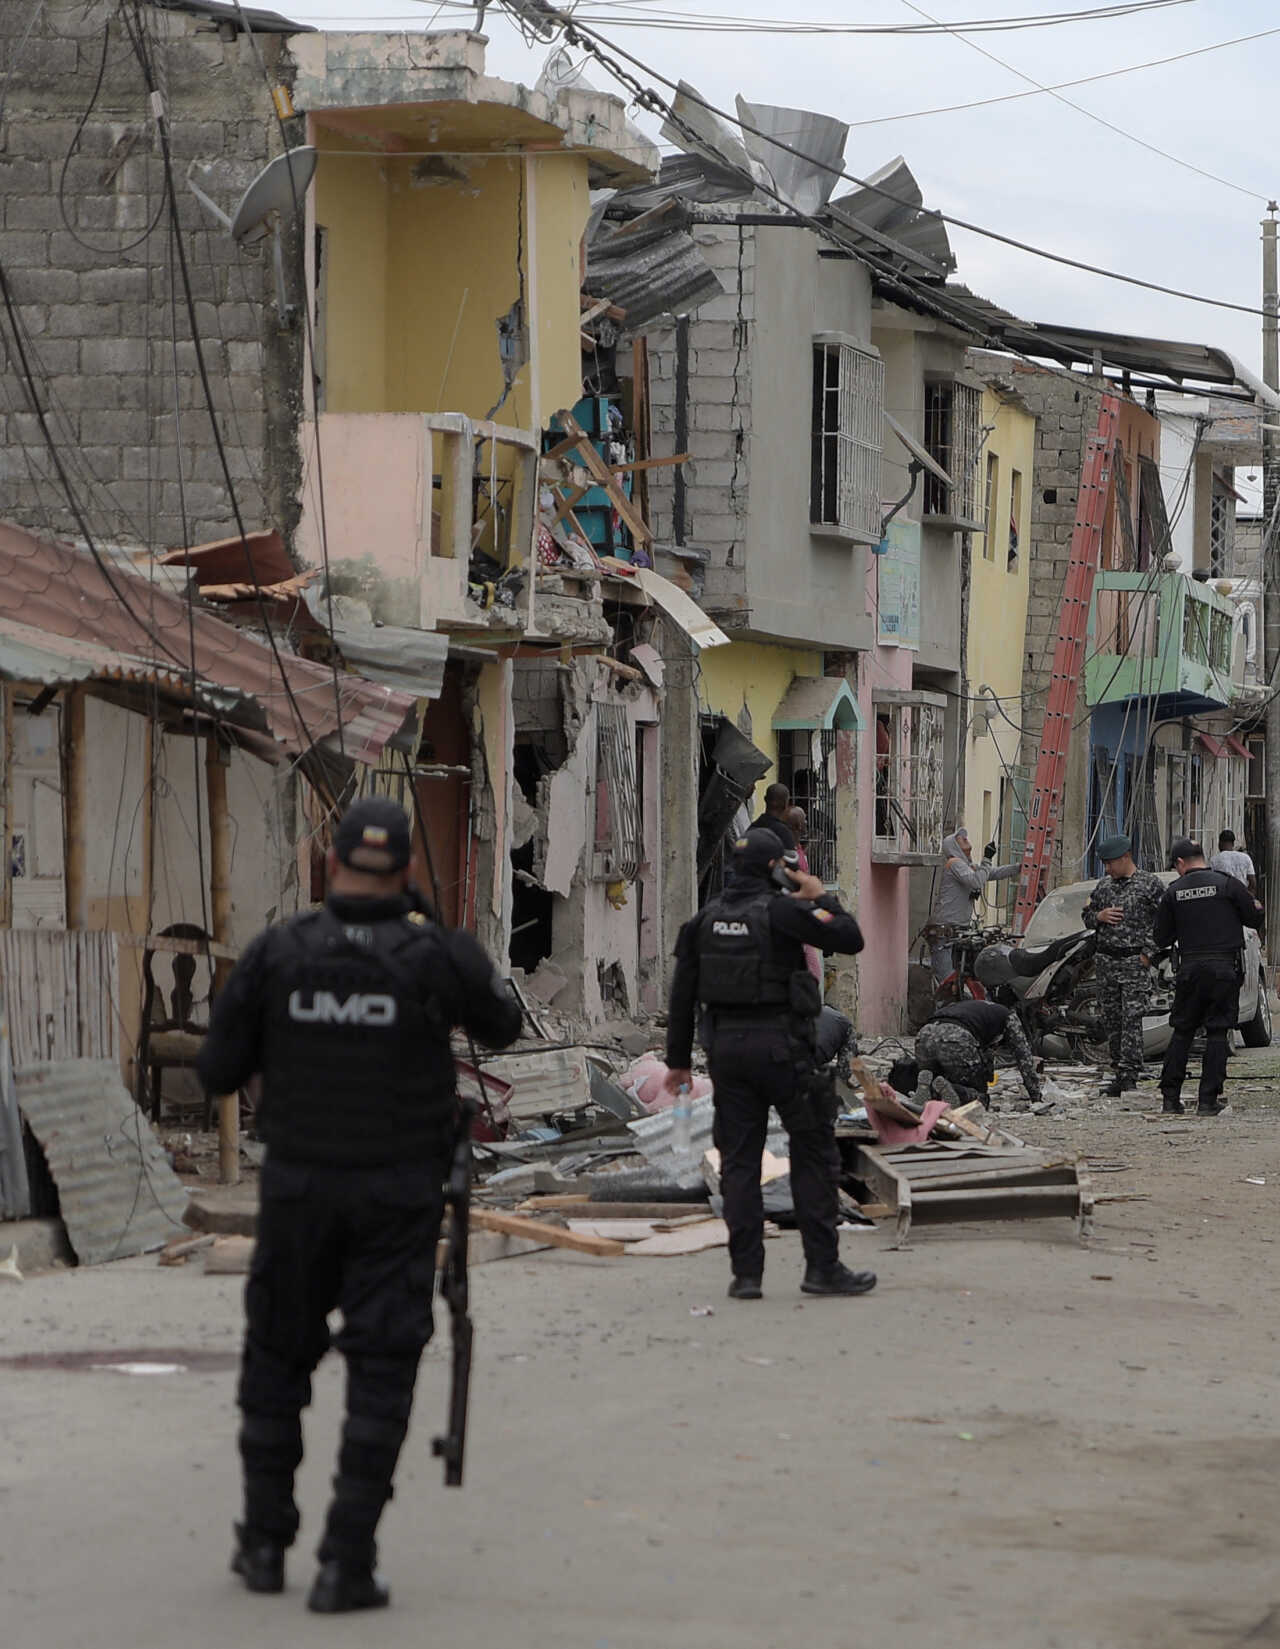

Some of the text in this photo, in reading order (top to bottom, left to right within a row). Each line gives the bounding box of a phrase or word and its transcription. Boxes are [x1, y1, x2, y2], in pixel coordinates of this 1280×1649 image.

[1177, 887, 1216, 900] POLICIA
[713, 921, 749, 936] POLICIA
[288, 990, 396, 1025] UMO
